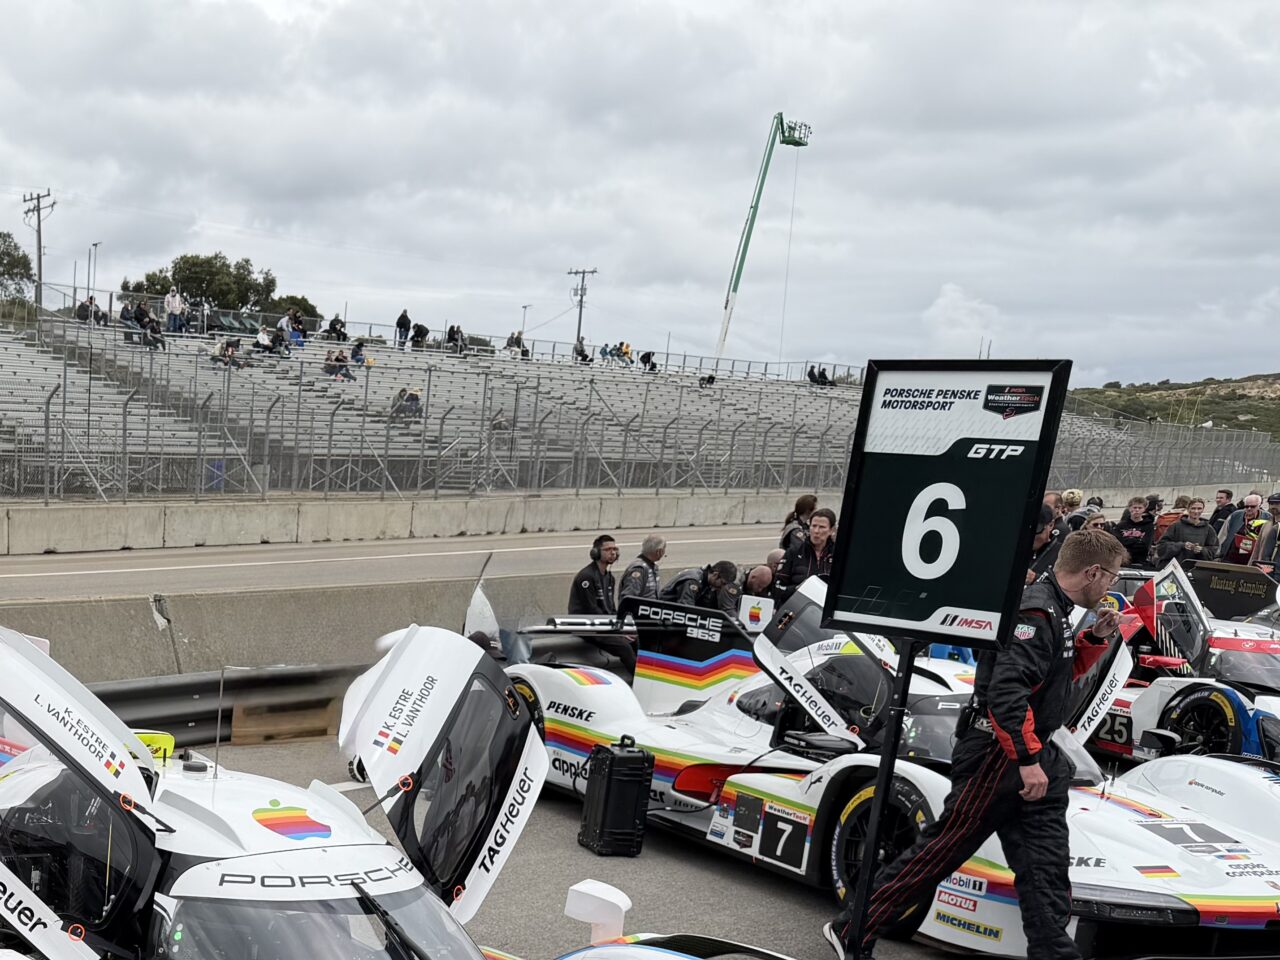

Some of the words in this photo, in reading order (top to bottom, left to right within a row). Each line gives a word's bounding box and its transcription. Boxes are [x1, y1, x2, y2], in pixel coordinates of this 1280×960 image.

[881, 400, 954, 411] MOTORSPORT
[883, 388, 935, 399] PORSCHE
[936, 389, 981, 400] PENSKE
[967, 444, 1025, 460] GTP
[901, 482, 966, 580] 6
[1210, 576, 1236, 595] Mustang
[1238, 579, 1268, 598] Sampling
[638, 605, 723, 631] PORSCHE
[956, 617, 993, 631] IMSA
[686, 627, 721, 642] 963
[389, 688, 414, 720] ESTRE
[402, 675, 438, 727] VANTHOOR
[546, 700, 596, 722] PENSKE
[34, 694, 43, 708] L.
[47, 703, 104, 762] VANTHOOR
[64, 707, 74, 721] K.
[76, 718, 110, 753] ESTRE
[1098, 713, 1128, 744] 25
[768, 804, 808, 823] WeatherTech
[776, 821, 793, 857] 7
[1161, 823, 1206, 843] 7
[219, 856, 414, 888] PORSCHE
[939, 891, 975, 911] MOTUL
[936, 912, 1000, 939] MICHELIN
